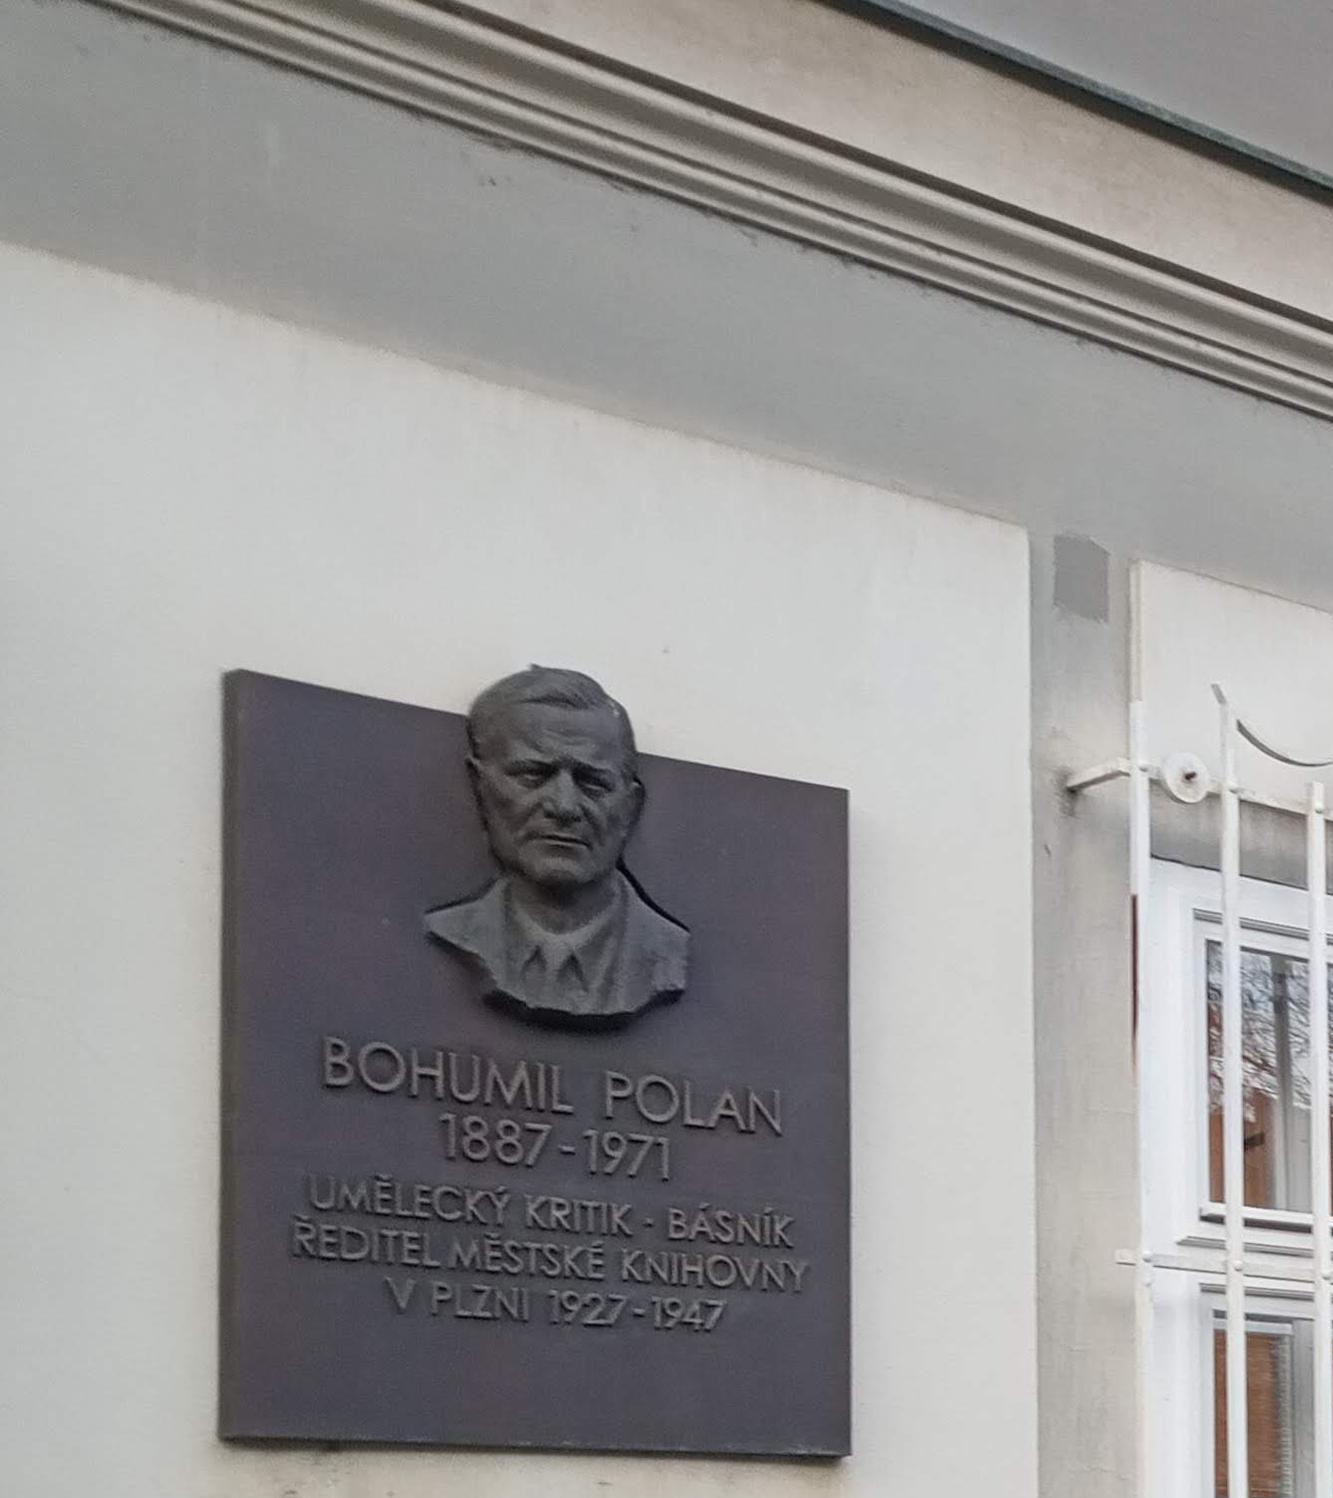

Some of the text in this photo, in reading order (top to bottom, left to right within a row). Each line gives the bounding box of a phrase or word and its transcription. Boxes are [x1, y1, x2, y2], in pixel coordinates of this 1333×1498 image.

[322, 1035, 784, 1137] BOHUMIL POLAN
[307, 1172, 511, 1226] UMĚLECKÝ
[524, 1194, 635, 1237] KRITIK
[667, 1202, 795, 1249] BÁSNÍK
[291, 1214, 809, 1293] ŘEDITEL MĚSTSKÉ KNIHOVNY
[385, 1275, 416, 1314] V
[430, 1280, 529, 1322] PLZNI
